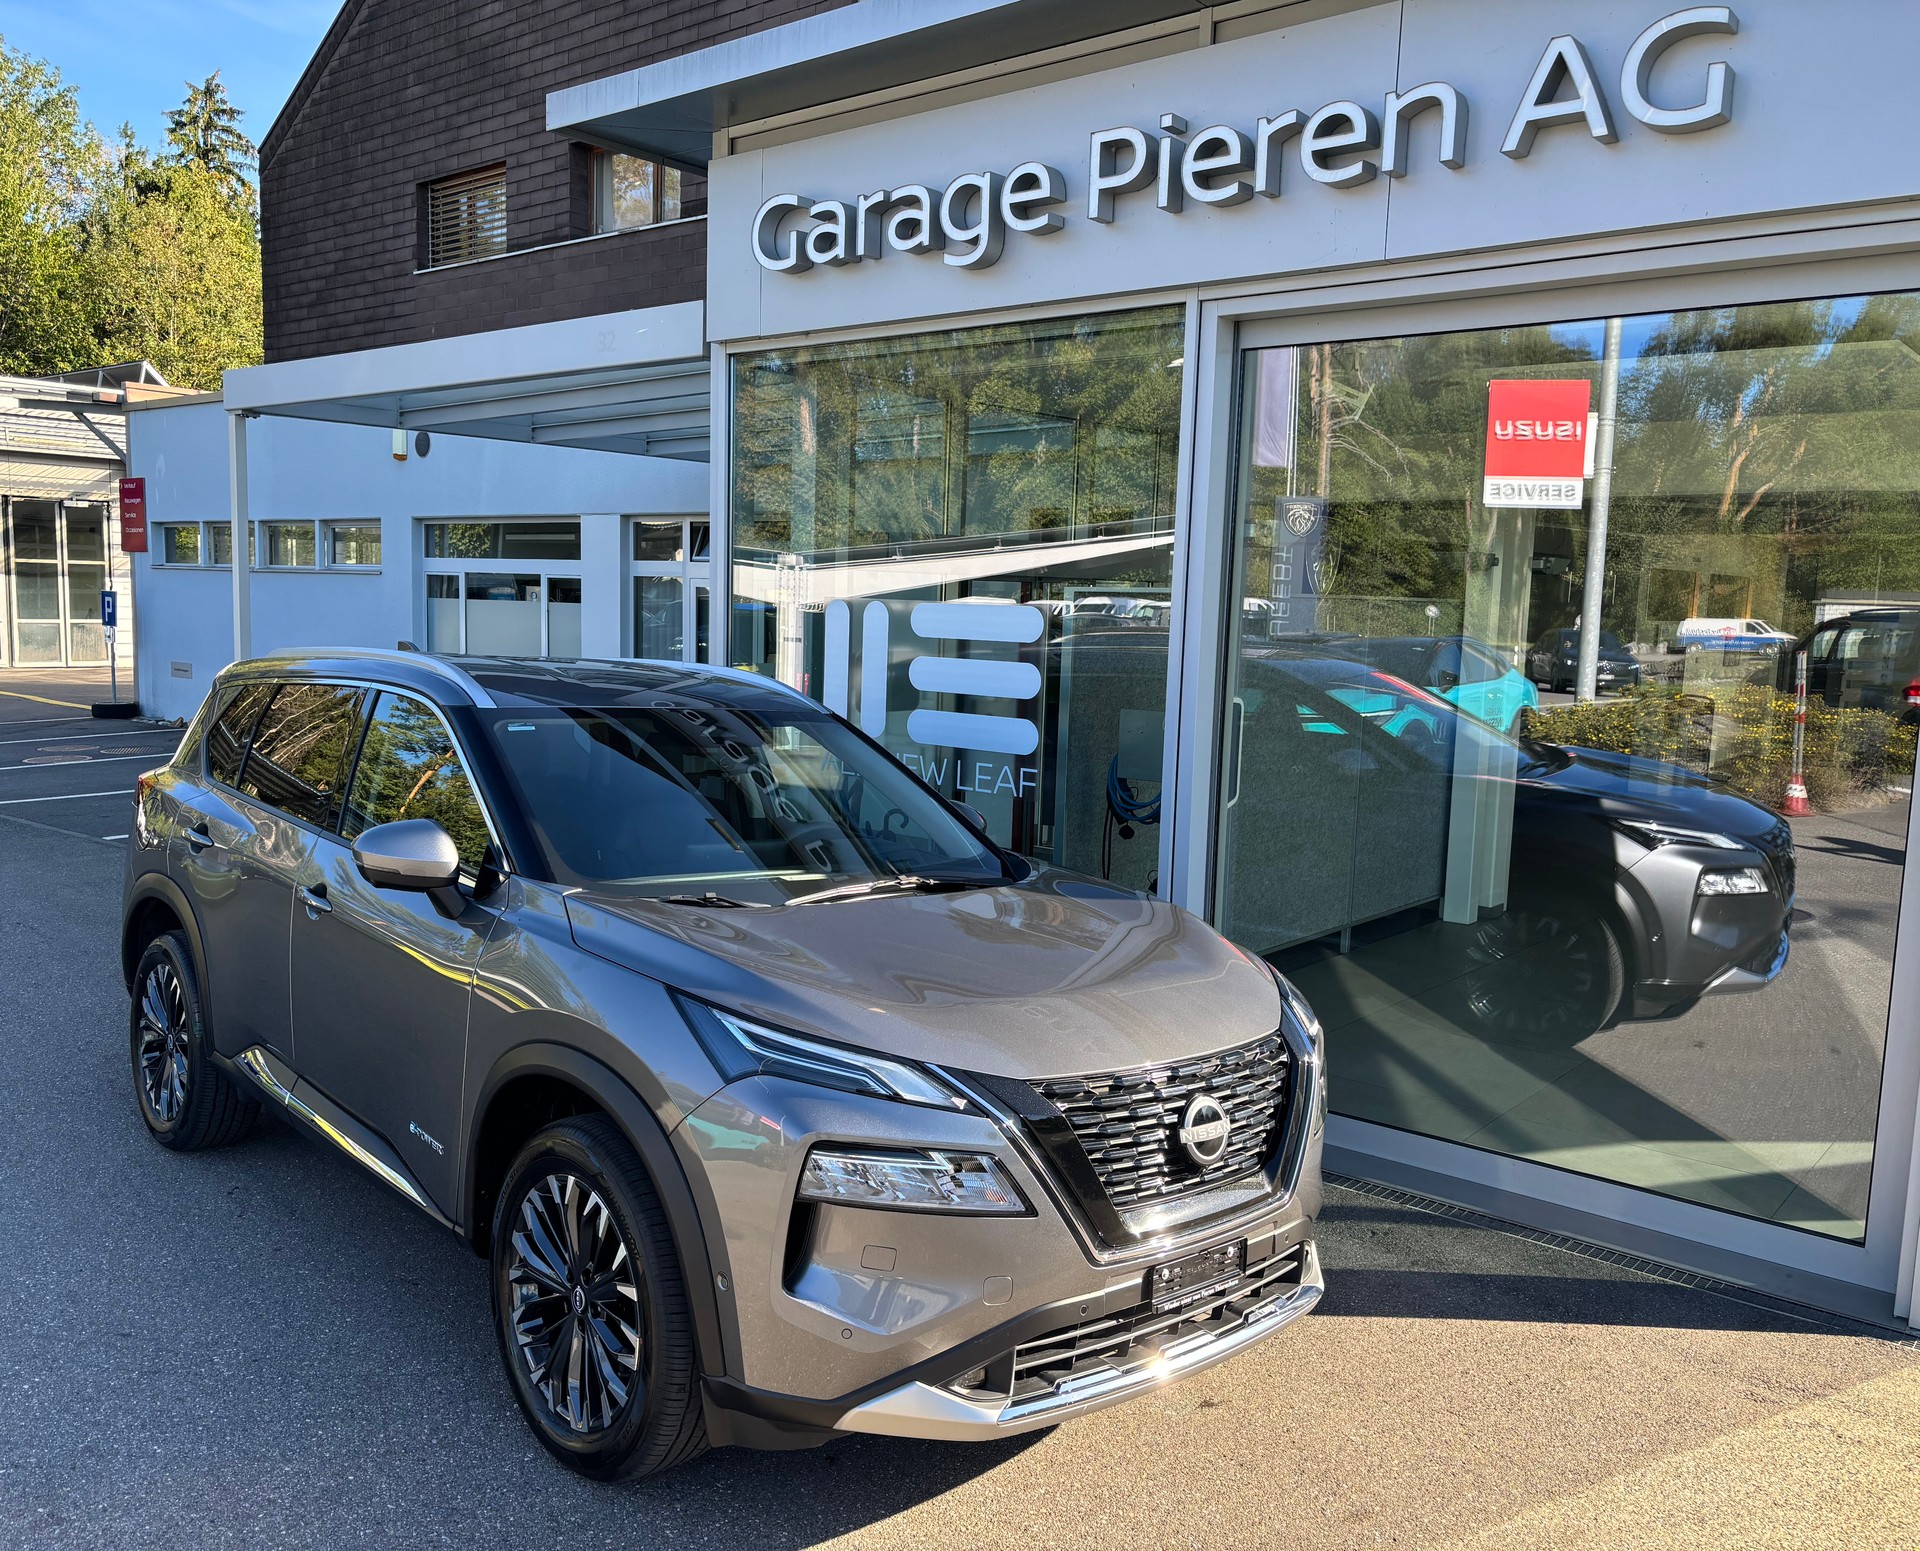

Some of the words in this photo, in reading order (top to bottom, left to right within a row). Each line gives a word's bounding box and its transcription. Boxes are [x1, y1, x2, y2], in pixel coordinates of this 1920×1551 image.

[751, 161, 1065, 273] Garage
[1087, 81, 1469, 225] Pieren
[1500, 6, 1739, 159] AG
[598, 330, 616, 353] 32
[105, 596, 113, 622] P
[896, 752, 948, 786] EW
[956, 759, 1039, 798] LEAF
[1181, 1115, 1231, 1142] NISSAN
